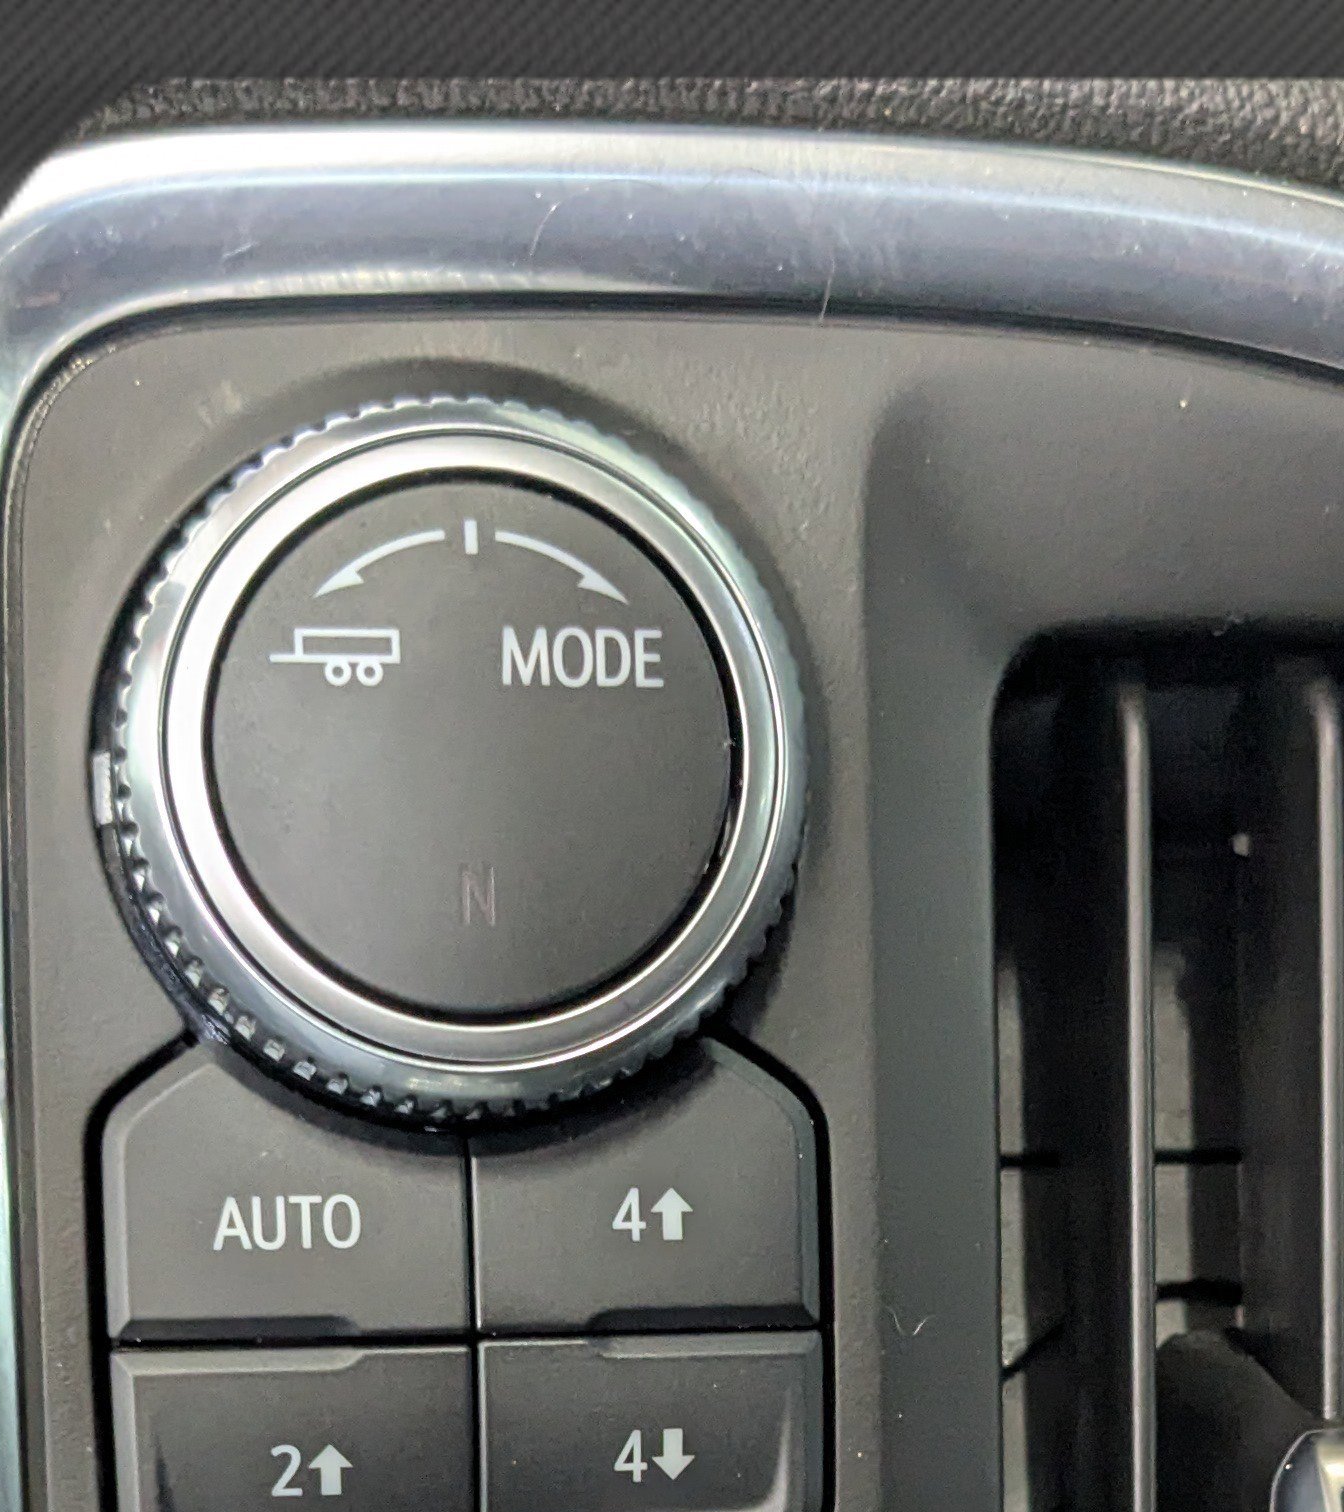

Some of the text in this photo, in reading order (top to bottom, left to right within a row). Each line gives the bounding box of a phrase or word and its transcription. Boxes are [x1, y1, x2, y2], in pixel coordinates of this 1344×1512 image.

[500, 624, 665, 689] MODE
[459, 864, 497, 927] N
[212, 1193, 362, 1252] AUTO
[611, 1187, 647, 1243] 4
[270, 1444, 303, 1498] 2
[613, 1429, 648, 1484] 4
